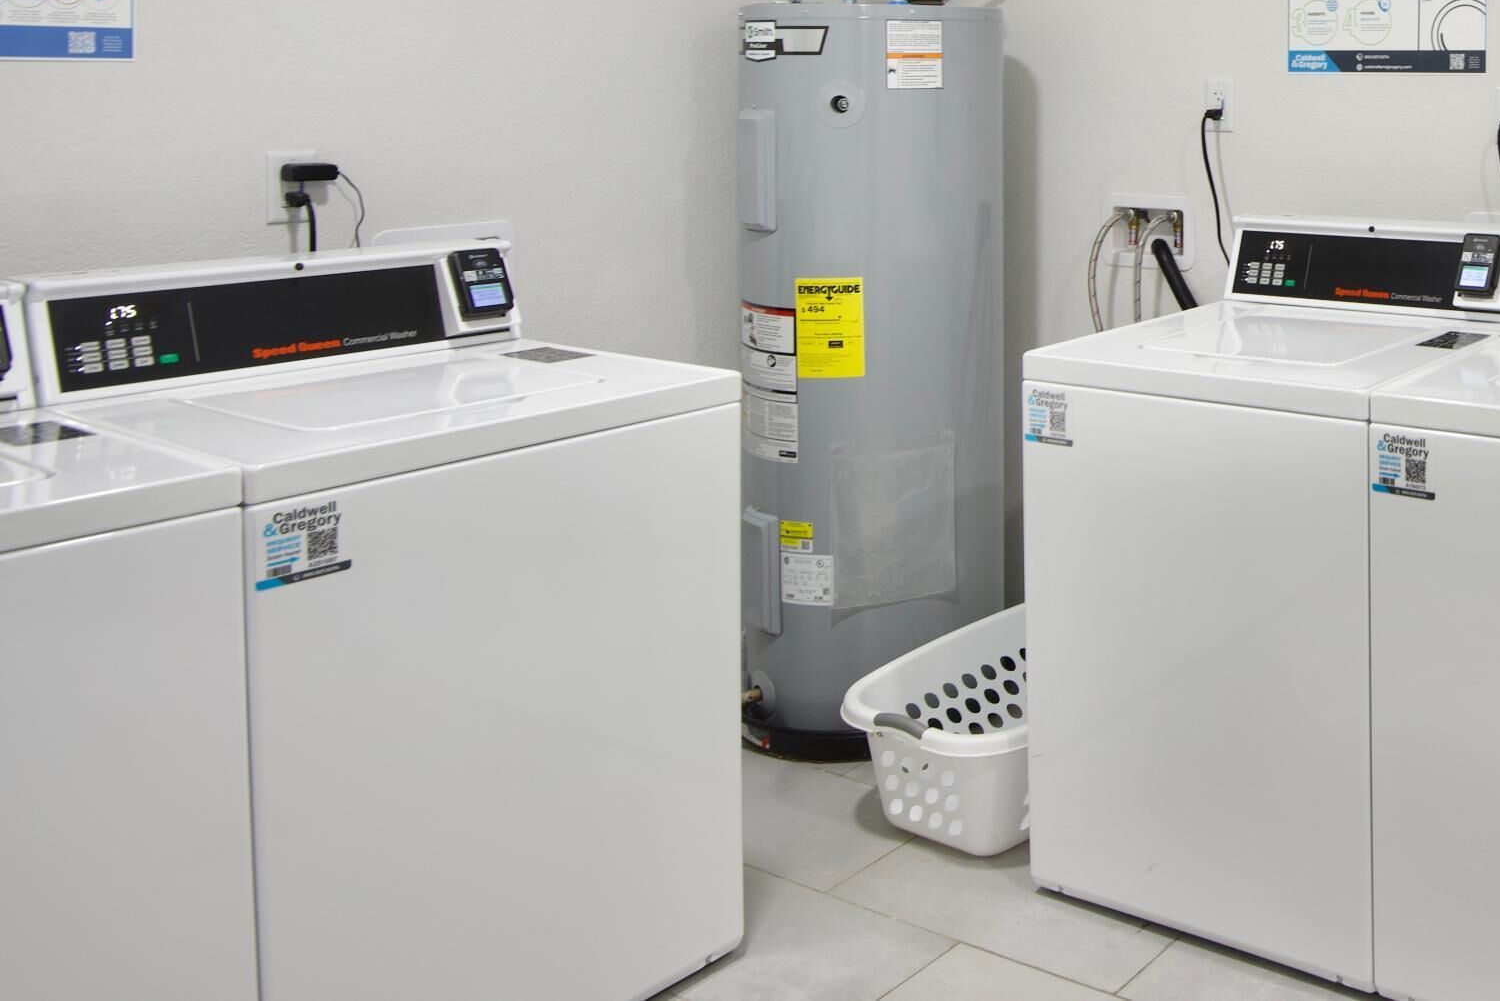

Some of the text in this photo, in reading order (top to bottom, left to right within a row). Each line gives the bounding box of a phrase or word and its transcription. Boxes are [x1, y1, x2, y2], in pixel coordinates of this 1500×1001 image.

[1335, 287, 1361, 297] Speed
[1391, 292, 1420, 301] Commercial
[252, 344, 296, 359] Speed
[298, 339, 341, 353] Queen
[343, 335, 388, 346] Commercial
[1383, 433, 1426, 448] Caldwell
[273, 501, 337, 524] Caldwell
